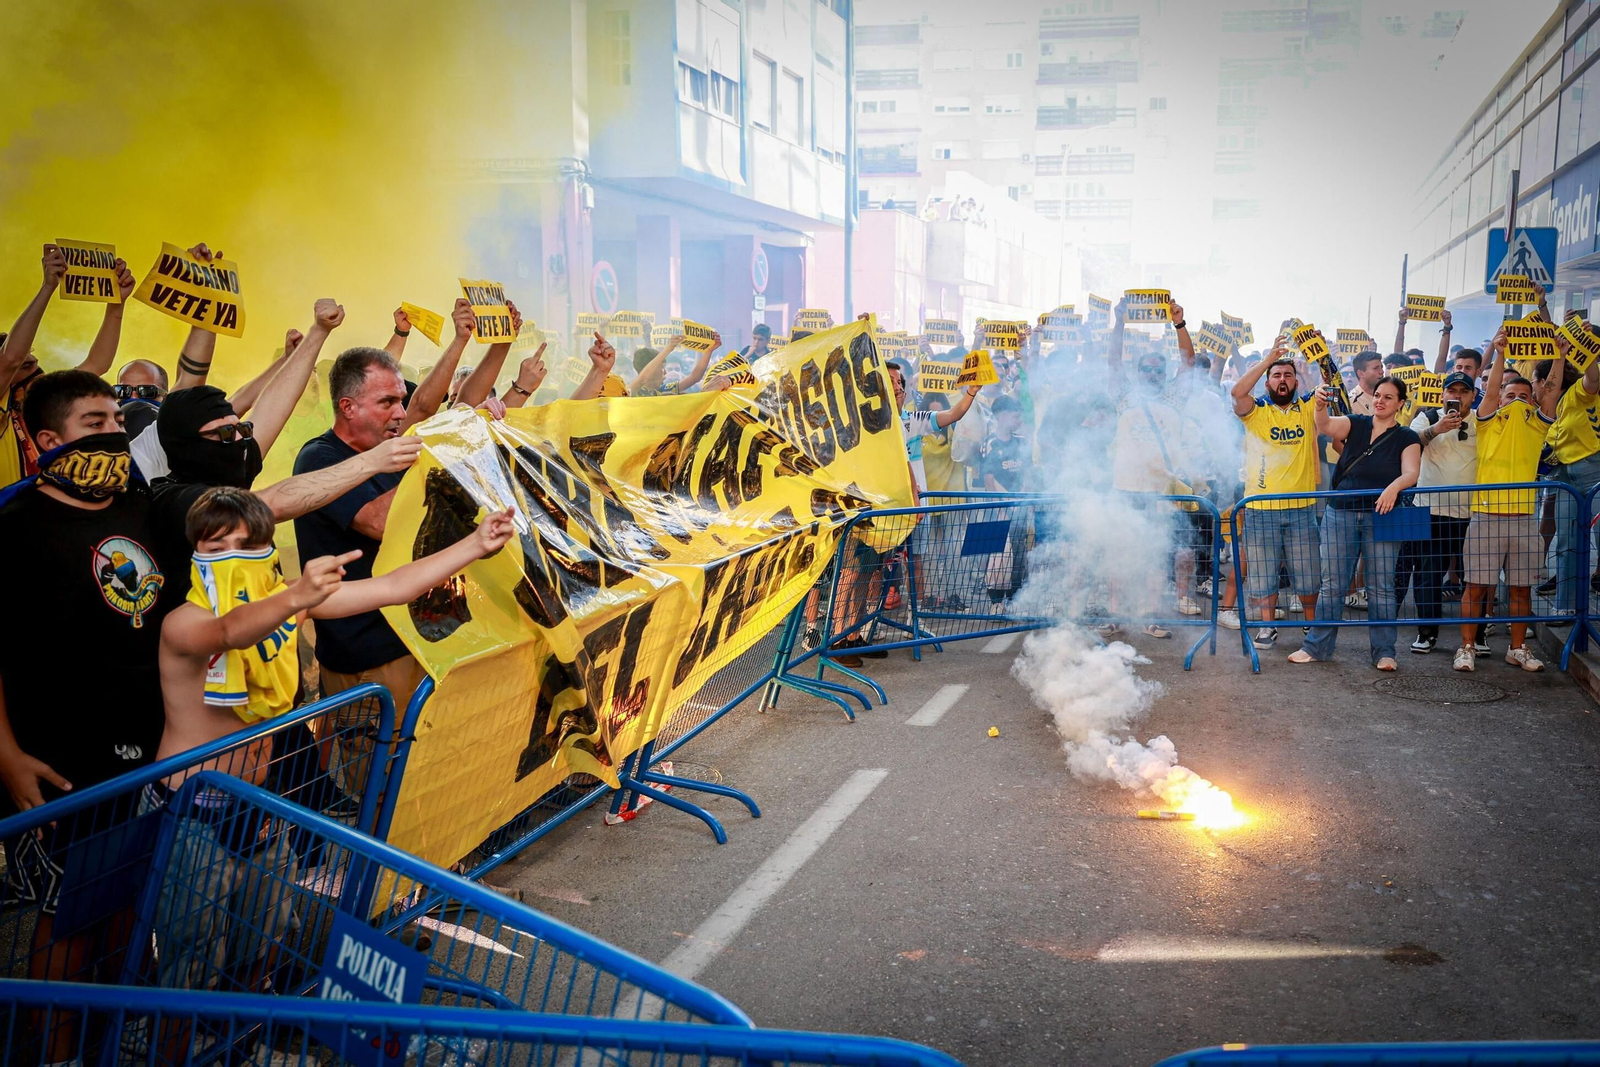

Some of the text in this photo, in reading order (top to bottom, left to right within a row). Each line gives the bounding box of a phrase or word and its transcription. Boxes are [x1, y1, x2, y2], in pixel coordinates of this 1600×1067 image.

[60, 247, 116, 270] VIZCAÍNO
[158, 254, 239, 295] VIZCAÍNO
[65, 274, 114, 298] VETE YA
[1126, 291, 1170, 304] VIZCAÍNO
[1408, 297, 1444, 308] VIZCAÍNO
[1501, 291, 1535, 302] VETE YA
[150, 283, 237, 329] VETE YA
[801, 311, 828, 319] VIZCAÍNO
[1128, 308, 1167, 320] VETE YA
[1408, 308, 1439, 320] VETE YA
[475, 315, 499, 337] VETE
[499, 315, 511, 336] YA
[925, 321, 958, 332] VIZCAÍNO
[1042, 315, 1081, 327] VIZCAÍNO
[609, 324, 639, 335] VETE YA
[1043, 329, 1077, 341] VETE YA
[1202, 321, 1233, 345] VIZCAÍNO
[1505, 326, 1555, 339] VIZCAÍNO
[926, 333, 955, 343] VETE YA
[985, 336, 1017, 347] VETE YA
[1565, 319, 1600, 354] VIZCAÍNO
[1198, 333, 1227, 355] VETE YA
[1307, 342, 1324, 353] YA
[1340, 343, 1358, 353] VETE
[1509, 343, 1537, 356] VETE
[1540, 343, 1555, 356] YA
[1572, 353, 1588, 366] YA
[921, 362, 961, 377] VIZCAÍNO
[923, 378, 944, 390] VETE
[336, 933, 407, 1005] POLICIA
